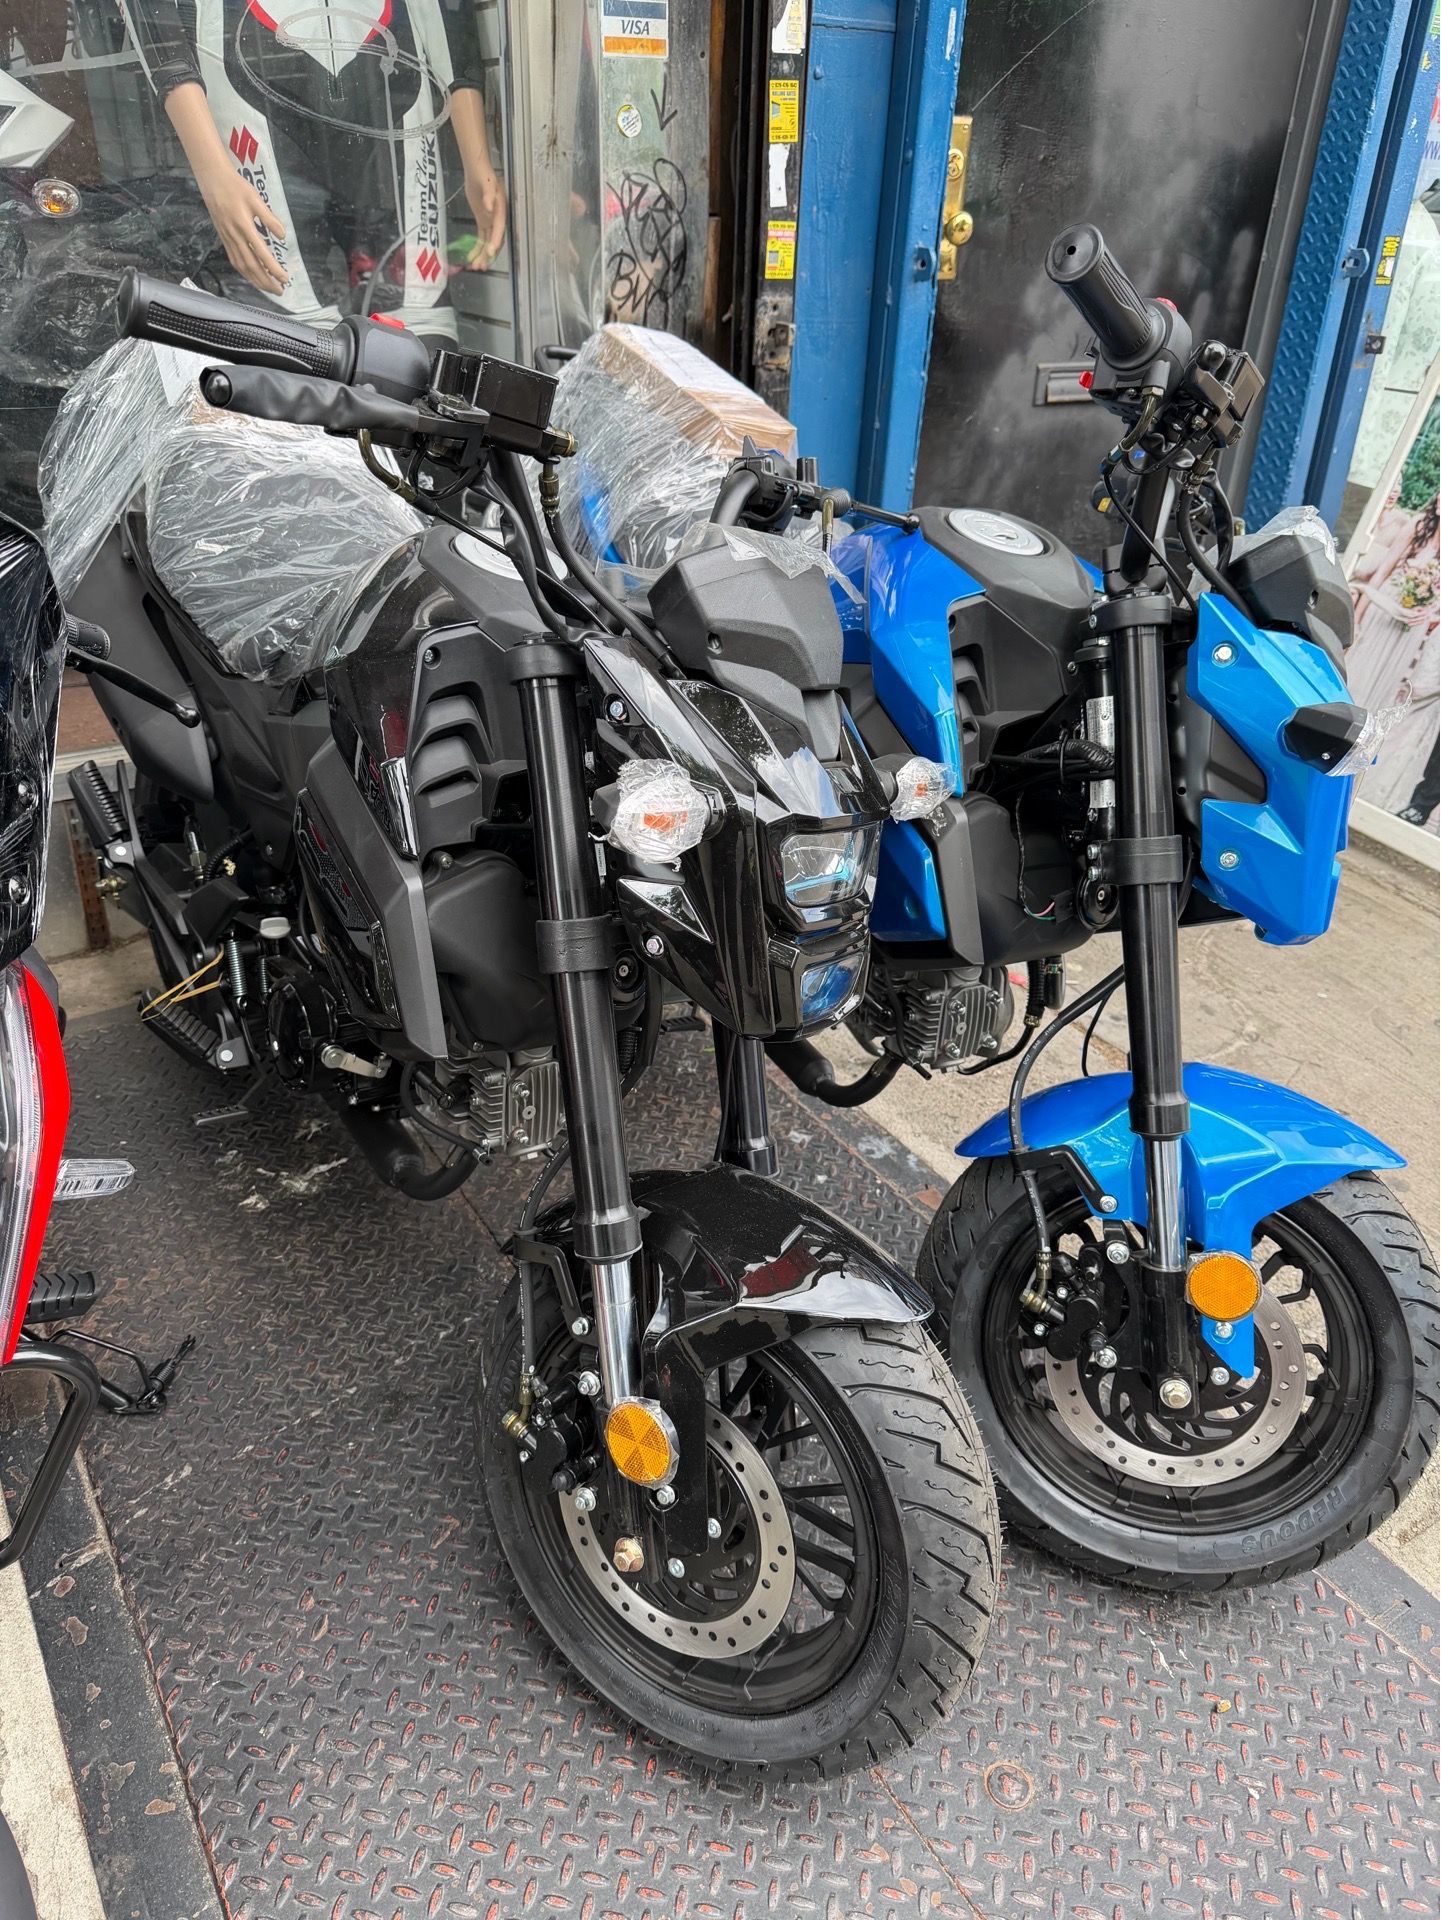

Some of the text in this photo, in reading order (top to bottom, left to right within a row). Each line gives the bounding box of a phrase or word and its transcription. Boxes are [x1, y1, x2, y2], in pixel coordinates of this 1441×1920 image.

[621, 19, 651, 36] VISA
[417, 191, 429, 246] Team
[1240, 1485, 1347, 1555] REDOUS
